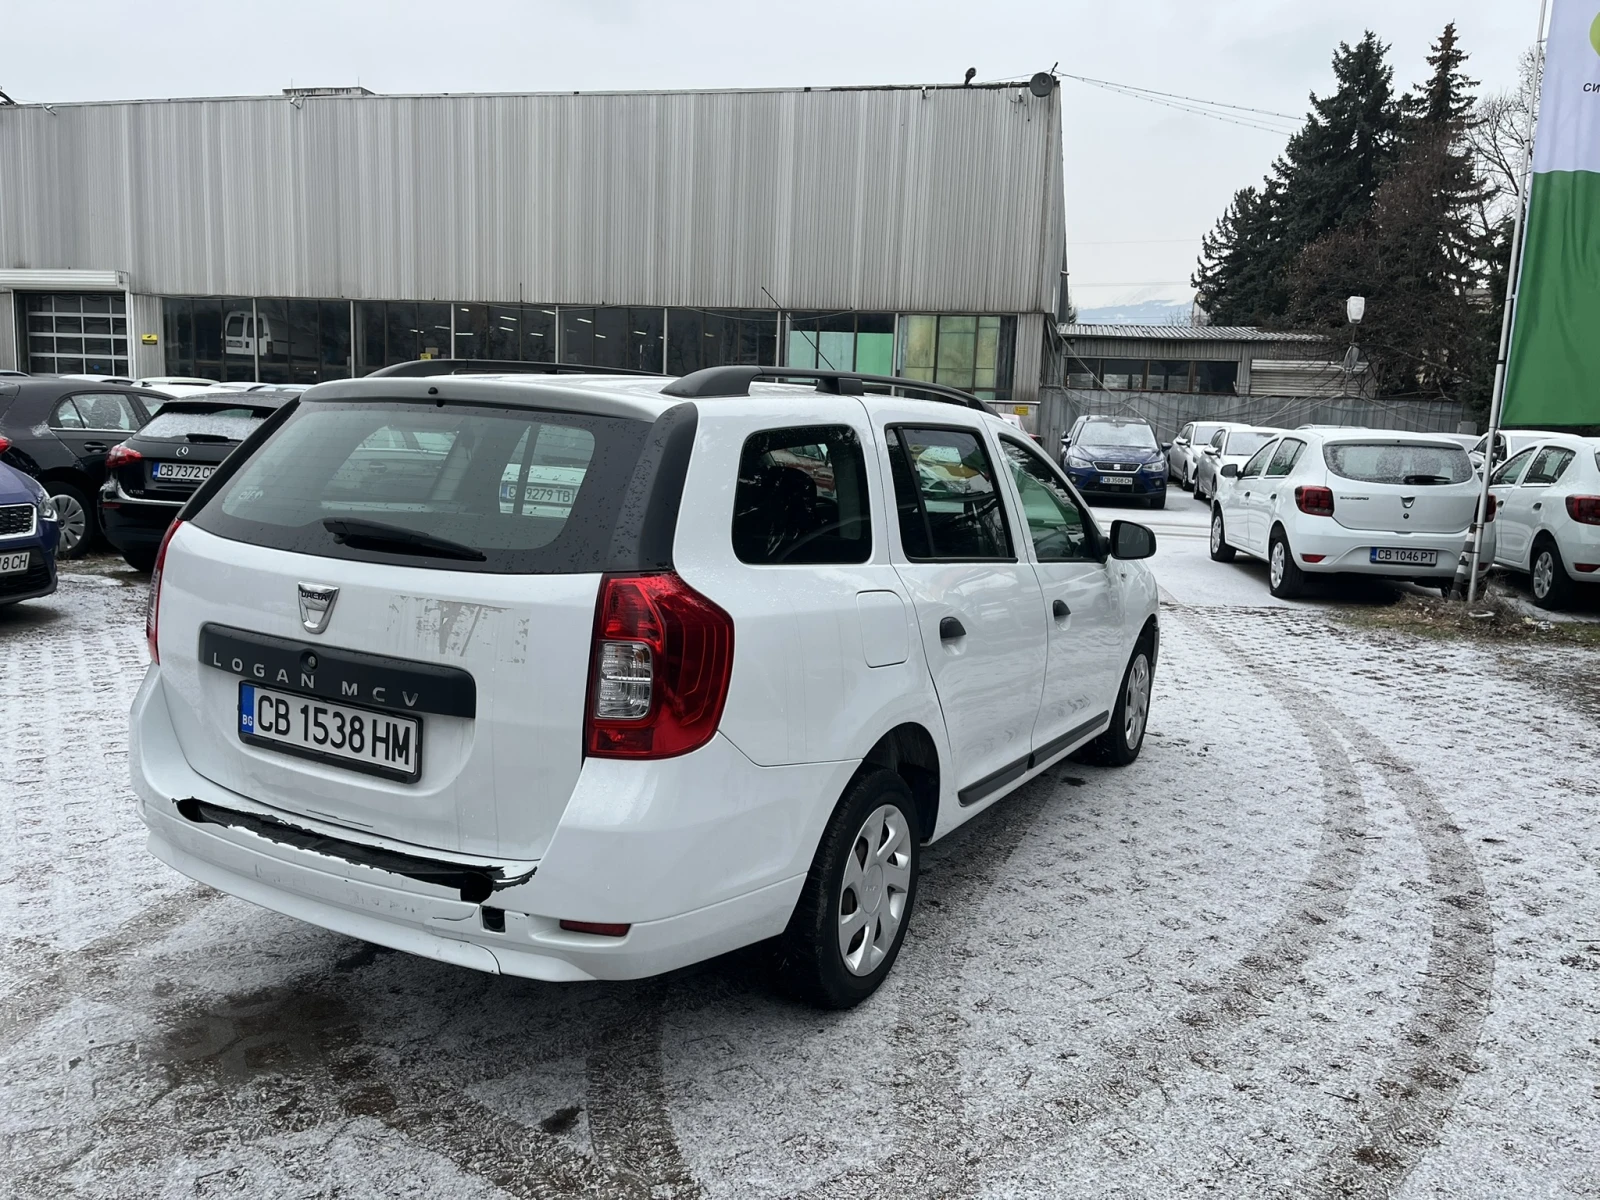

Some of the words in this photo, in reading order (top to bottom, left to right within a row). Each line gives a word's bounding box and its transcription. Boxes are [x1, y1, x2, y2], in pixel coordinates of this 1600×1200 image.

[159, 464, 173, 476] CB
[175, 465, 201, 478] 7372
[526, 487, 553, 501] 9279
[555, 489, 571, 502] TB
[11, 554, 28, 570] CH
[1378, 549, 1391, 560] CB
[1395, 550, 1419, 561] 1046
[1420, 552, 1435, 562] PT
[301, 590, 328, 602] DACIA
[213, 652, 315, 689] LOGAN
[341, 680, 419, 707] MCV
[242, 714, 253, 727] BG
[258, 695, 291, 736] CB
[300, 704, 365, 753] 1538
[371, 719, 411, 765] HM
